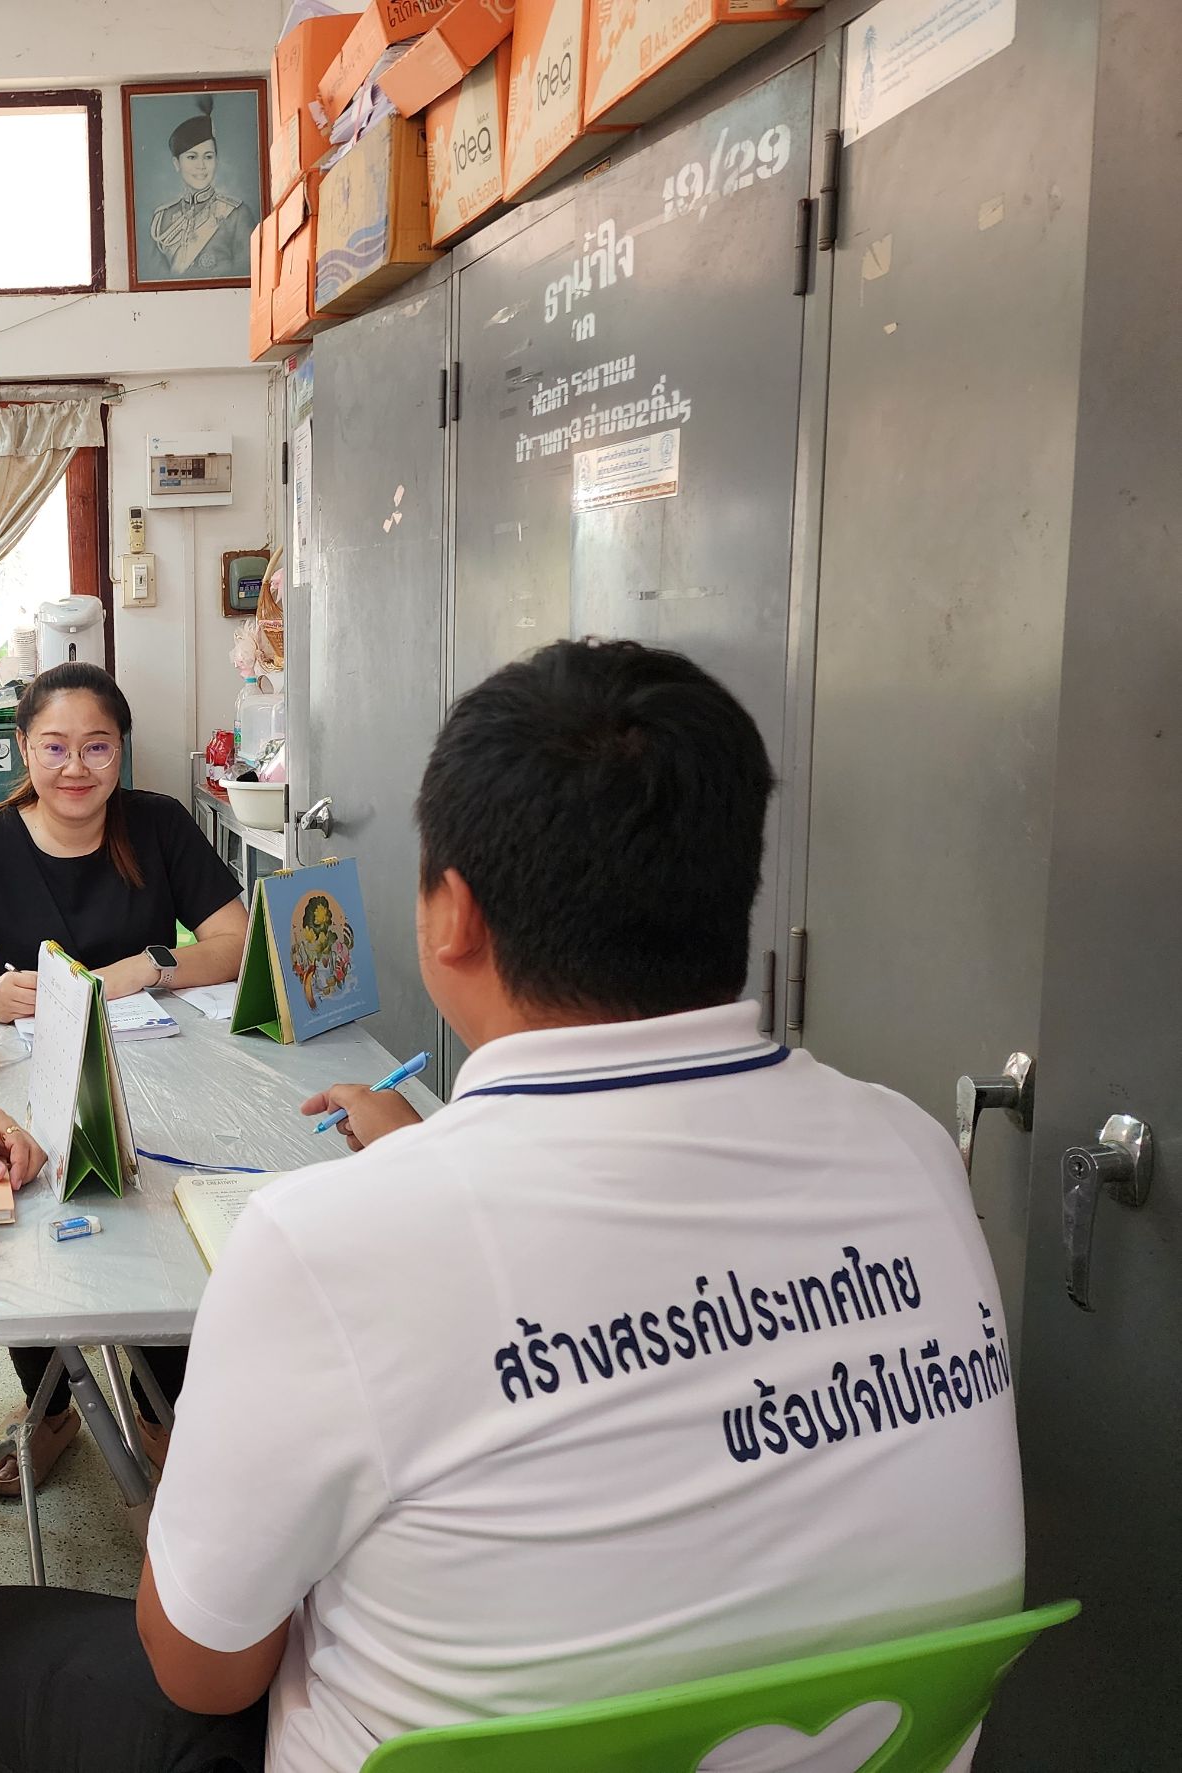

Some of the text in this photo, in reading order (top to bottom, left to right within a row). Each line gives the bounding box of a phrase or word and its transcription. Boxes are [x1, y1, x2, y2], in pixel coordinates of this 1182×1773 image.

[537, 52, 572, 111] idea
[452, 126, 492, 176] idea
[494, 1246, 921, 1404] สร้างสรรค์ประเทศไทย
[722, 1301, 1010, 1463] พร้อมใจไปเลือกตั้ง
